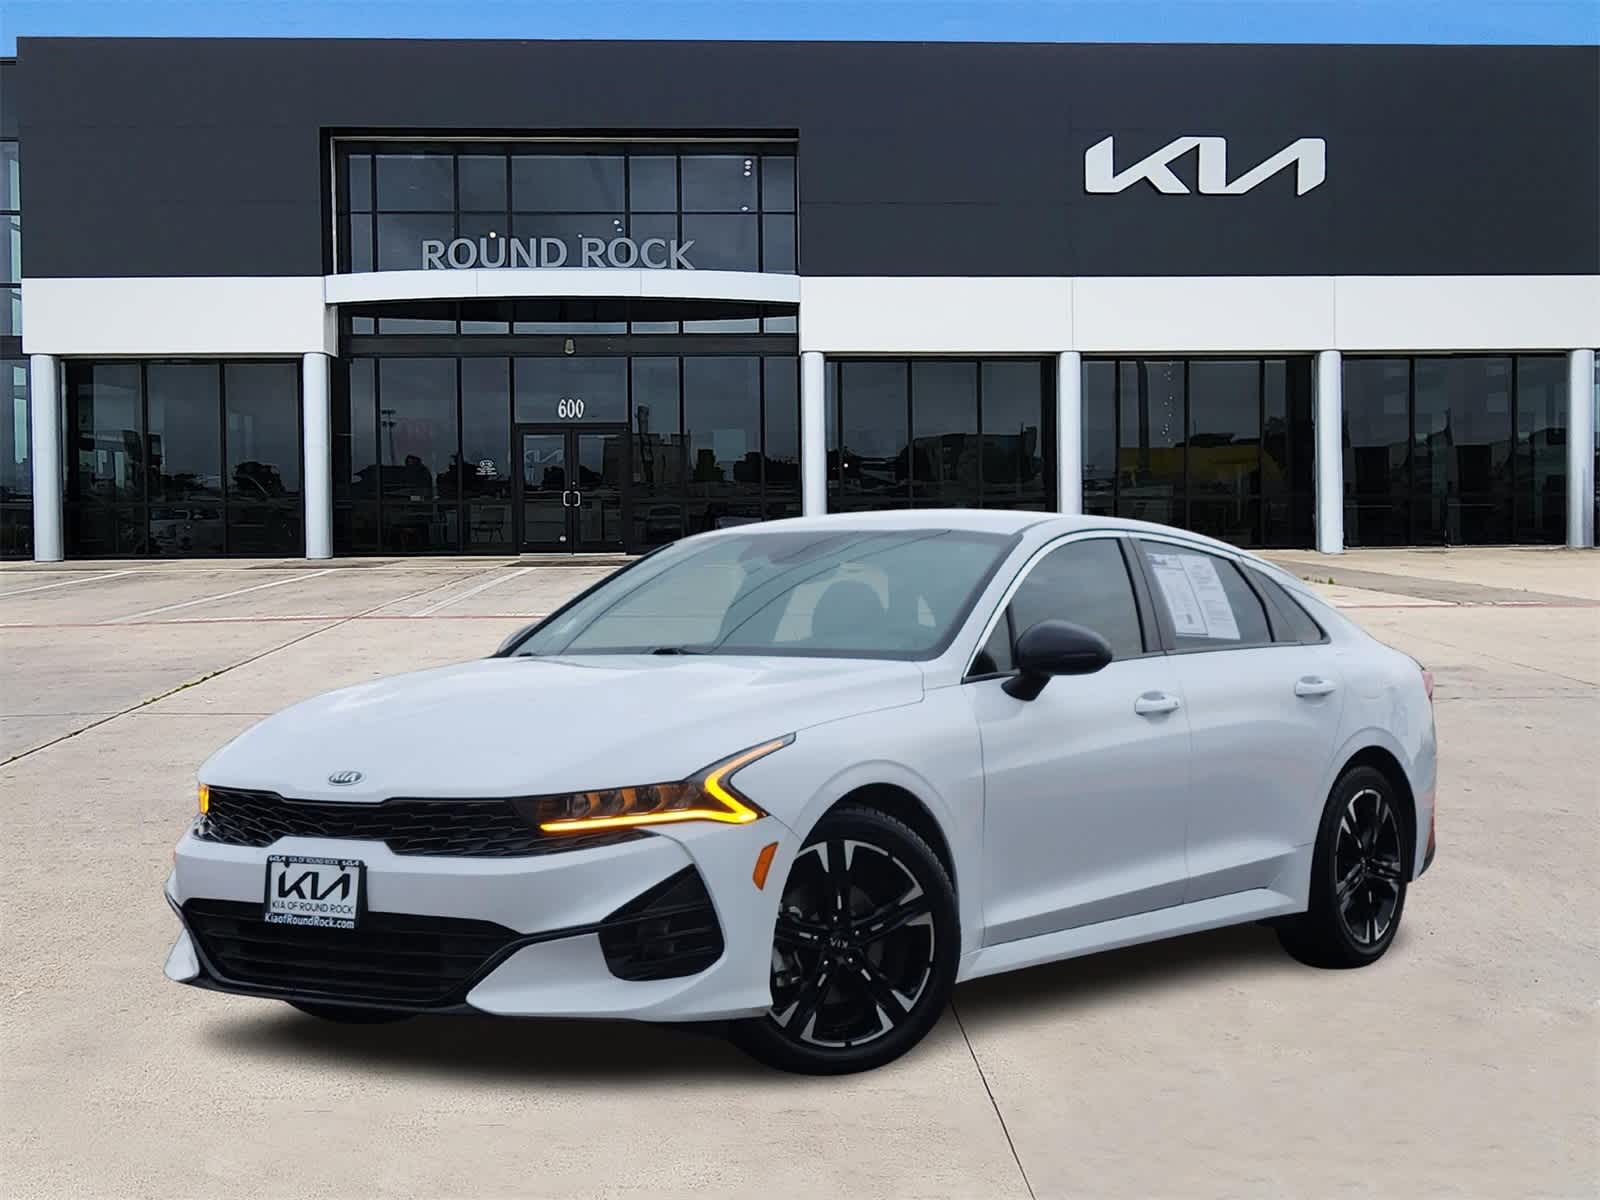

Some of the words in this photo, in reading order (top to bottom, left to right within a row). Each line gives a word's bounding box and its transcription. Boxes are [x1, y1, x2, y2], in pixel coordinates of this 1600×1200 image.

[1085, 135, 1326, 196] KIA
[422, 237, 567, 270] ROUND
[582, 237, 696, 270] ROCK
[558, 399, 585, 418] 600
[278, 870, 351, 901] KIA
[272, 901, 286, 909] KIA
[287, 901, 298, 911] OF
[300, 902, 329, 912] ROUND
[330, 904, 354, 914] ROCK
[264, 912, 355, 929] KiaofRoundRock.com
